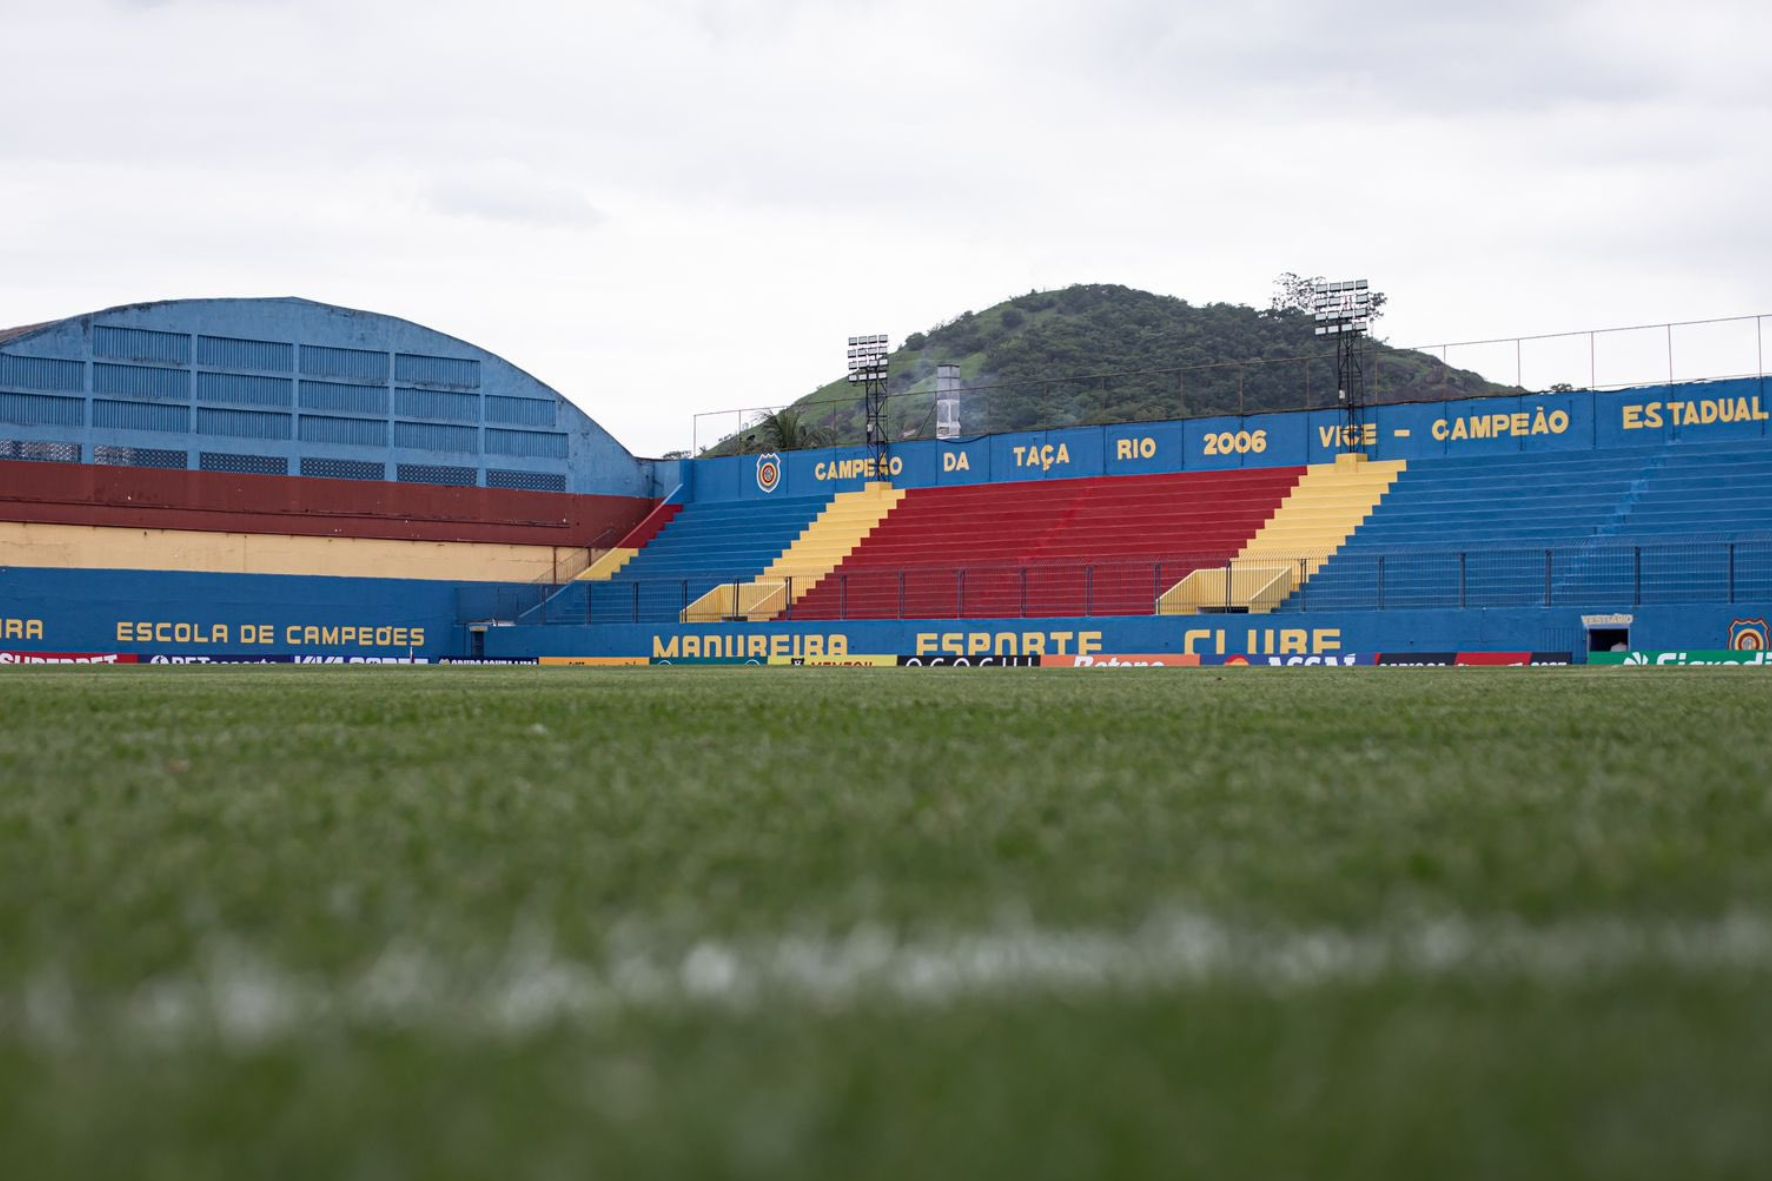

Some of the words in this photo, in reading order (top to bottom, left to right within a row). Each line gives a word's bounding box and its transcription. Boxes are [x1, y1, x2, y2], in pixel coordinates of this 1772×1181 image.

[814, 451, 903, 480] CAMPEÃO
[943, 452, 970, 472] DA
[1013, 443, 1071, 471] TAÇA
[1117, 437, 1157, 460] RIO
[1204, 430, 1267, 456] 2006
[1319, 423, 1377, 448] VICE
[1431, 407, 1569, 440] CAMPEÃO
[1622, 396, 1769, 430] ESTADUAL
[117, 621, 229, 643] ESCOLA
[240, 624, 274, 644] DE
[653, 634, 848, 658] MADUREIRA
[916, 631, 1103, 656] ESPORTE
